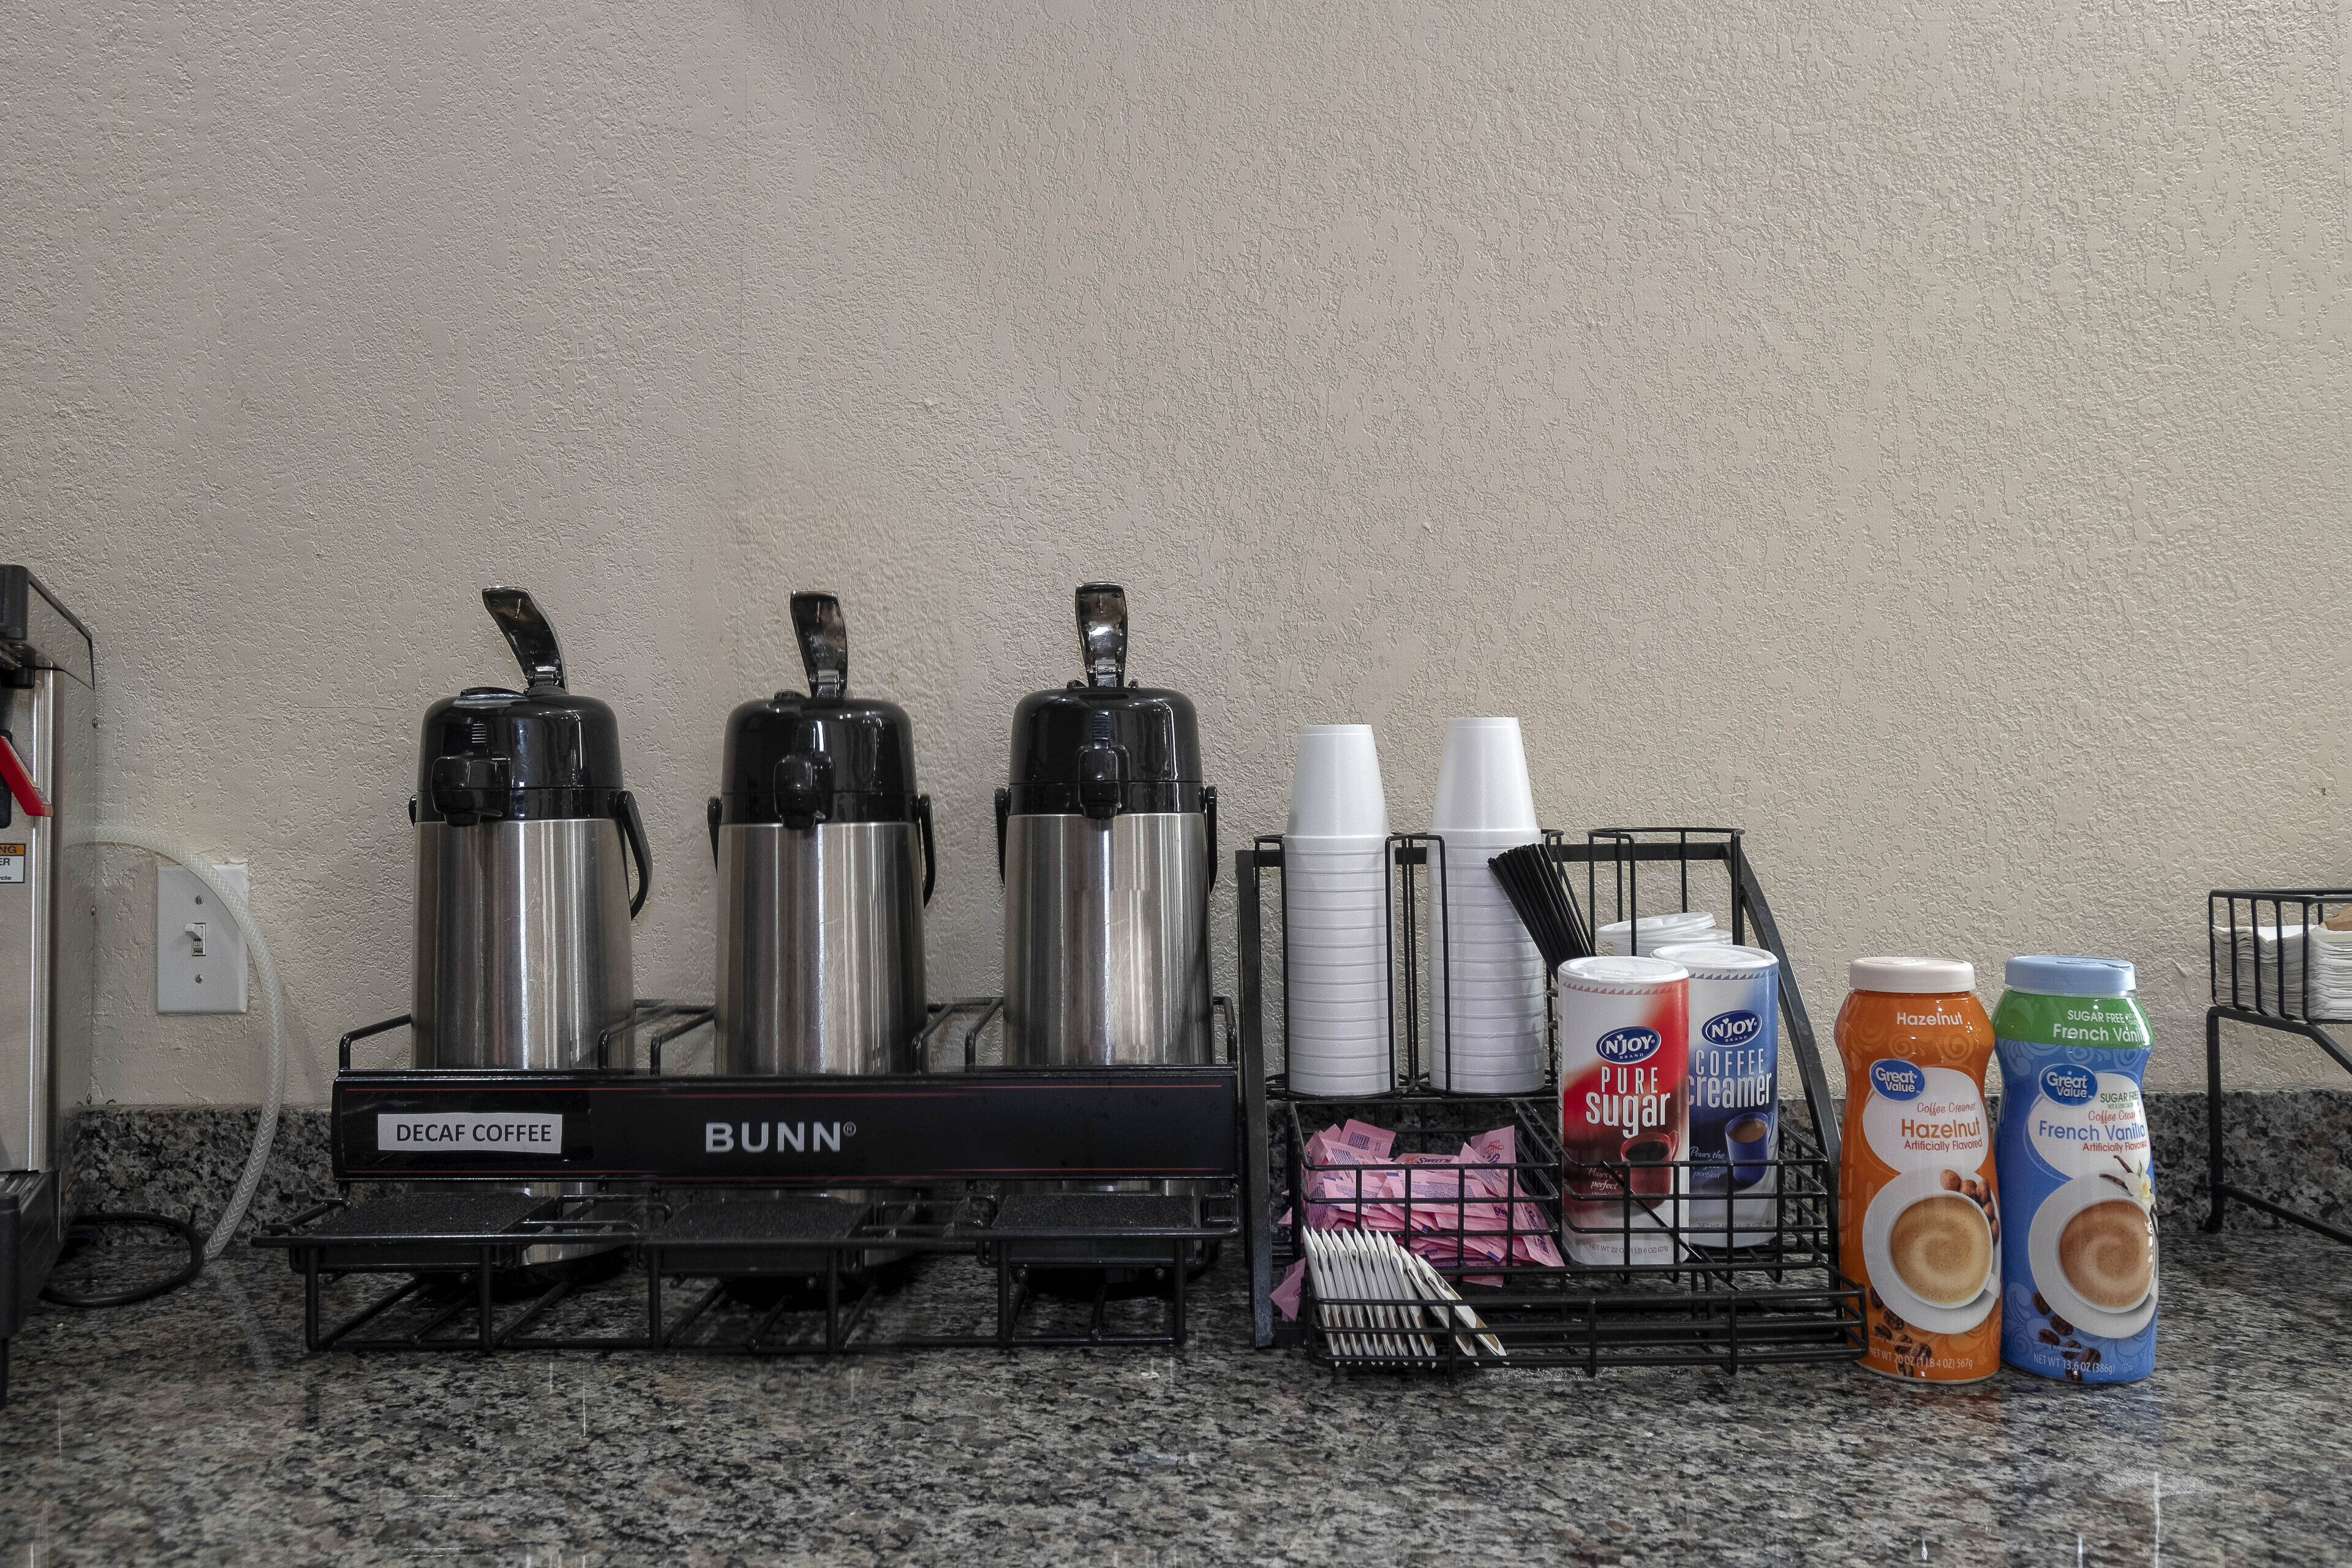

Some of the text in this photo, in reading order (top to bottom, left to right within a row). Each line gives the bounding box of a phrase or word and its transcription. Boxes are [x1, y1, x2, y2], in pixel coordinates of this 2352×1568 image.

[1896, 1012, 1963, 1025] Hazelnut
[2067, 1009, 2104, 1022] SUGAR
[2106, 1012, 2125, 1023] FREE
[2053, 1023, 2109, 1041] French
[1695, 1048, 1764, 1077] COFFEE
[1601, 1066, 1658, 1095] PURE
[1875, 1067, 1915, 1084] Great
[2046, 1072, 2088, 1089] Great
[1689, 1072, 1772, 1109] creamer
[1885, 1081, 1915, 1093] Value
[2057, 1087, 2087, 1098] Value
[2100, 1090, 2139, 1103] SUGAR FREE
[1586, 1091, 1671, 1139] sugar
[1917, 1102, 1976, 1116] Coffee Creamer
[2088, 1110, 2117, 1124] Coffee
[397, 1124, 552, 1142] DECAF COFFEE
[1901, 1117, 1980, 1138] Hazelnut
[2039, 1120, 2145, 1141] French Vanilla
[706, 1121, 840, 1153] BUNN
[1904, 1137, 1983, 1153] Artificially Flavored
[1689, 1147, 1725, 1159] Pours the
[2082, 1140, 2146, 1153] Artificially Flavored
[1692, 1170, 1720, 1179] portion
[1591, 1179, 1618, 1191] perfect
[1869, 1348, 1973, 1370] NET WT 20 OZ (1 LB 4 OZ) 567g
[2034, 1353, 2116, 1374] NET WT 13.6 OZ (386g)
